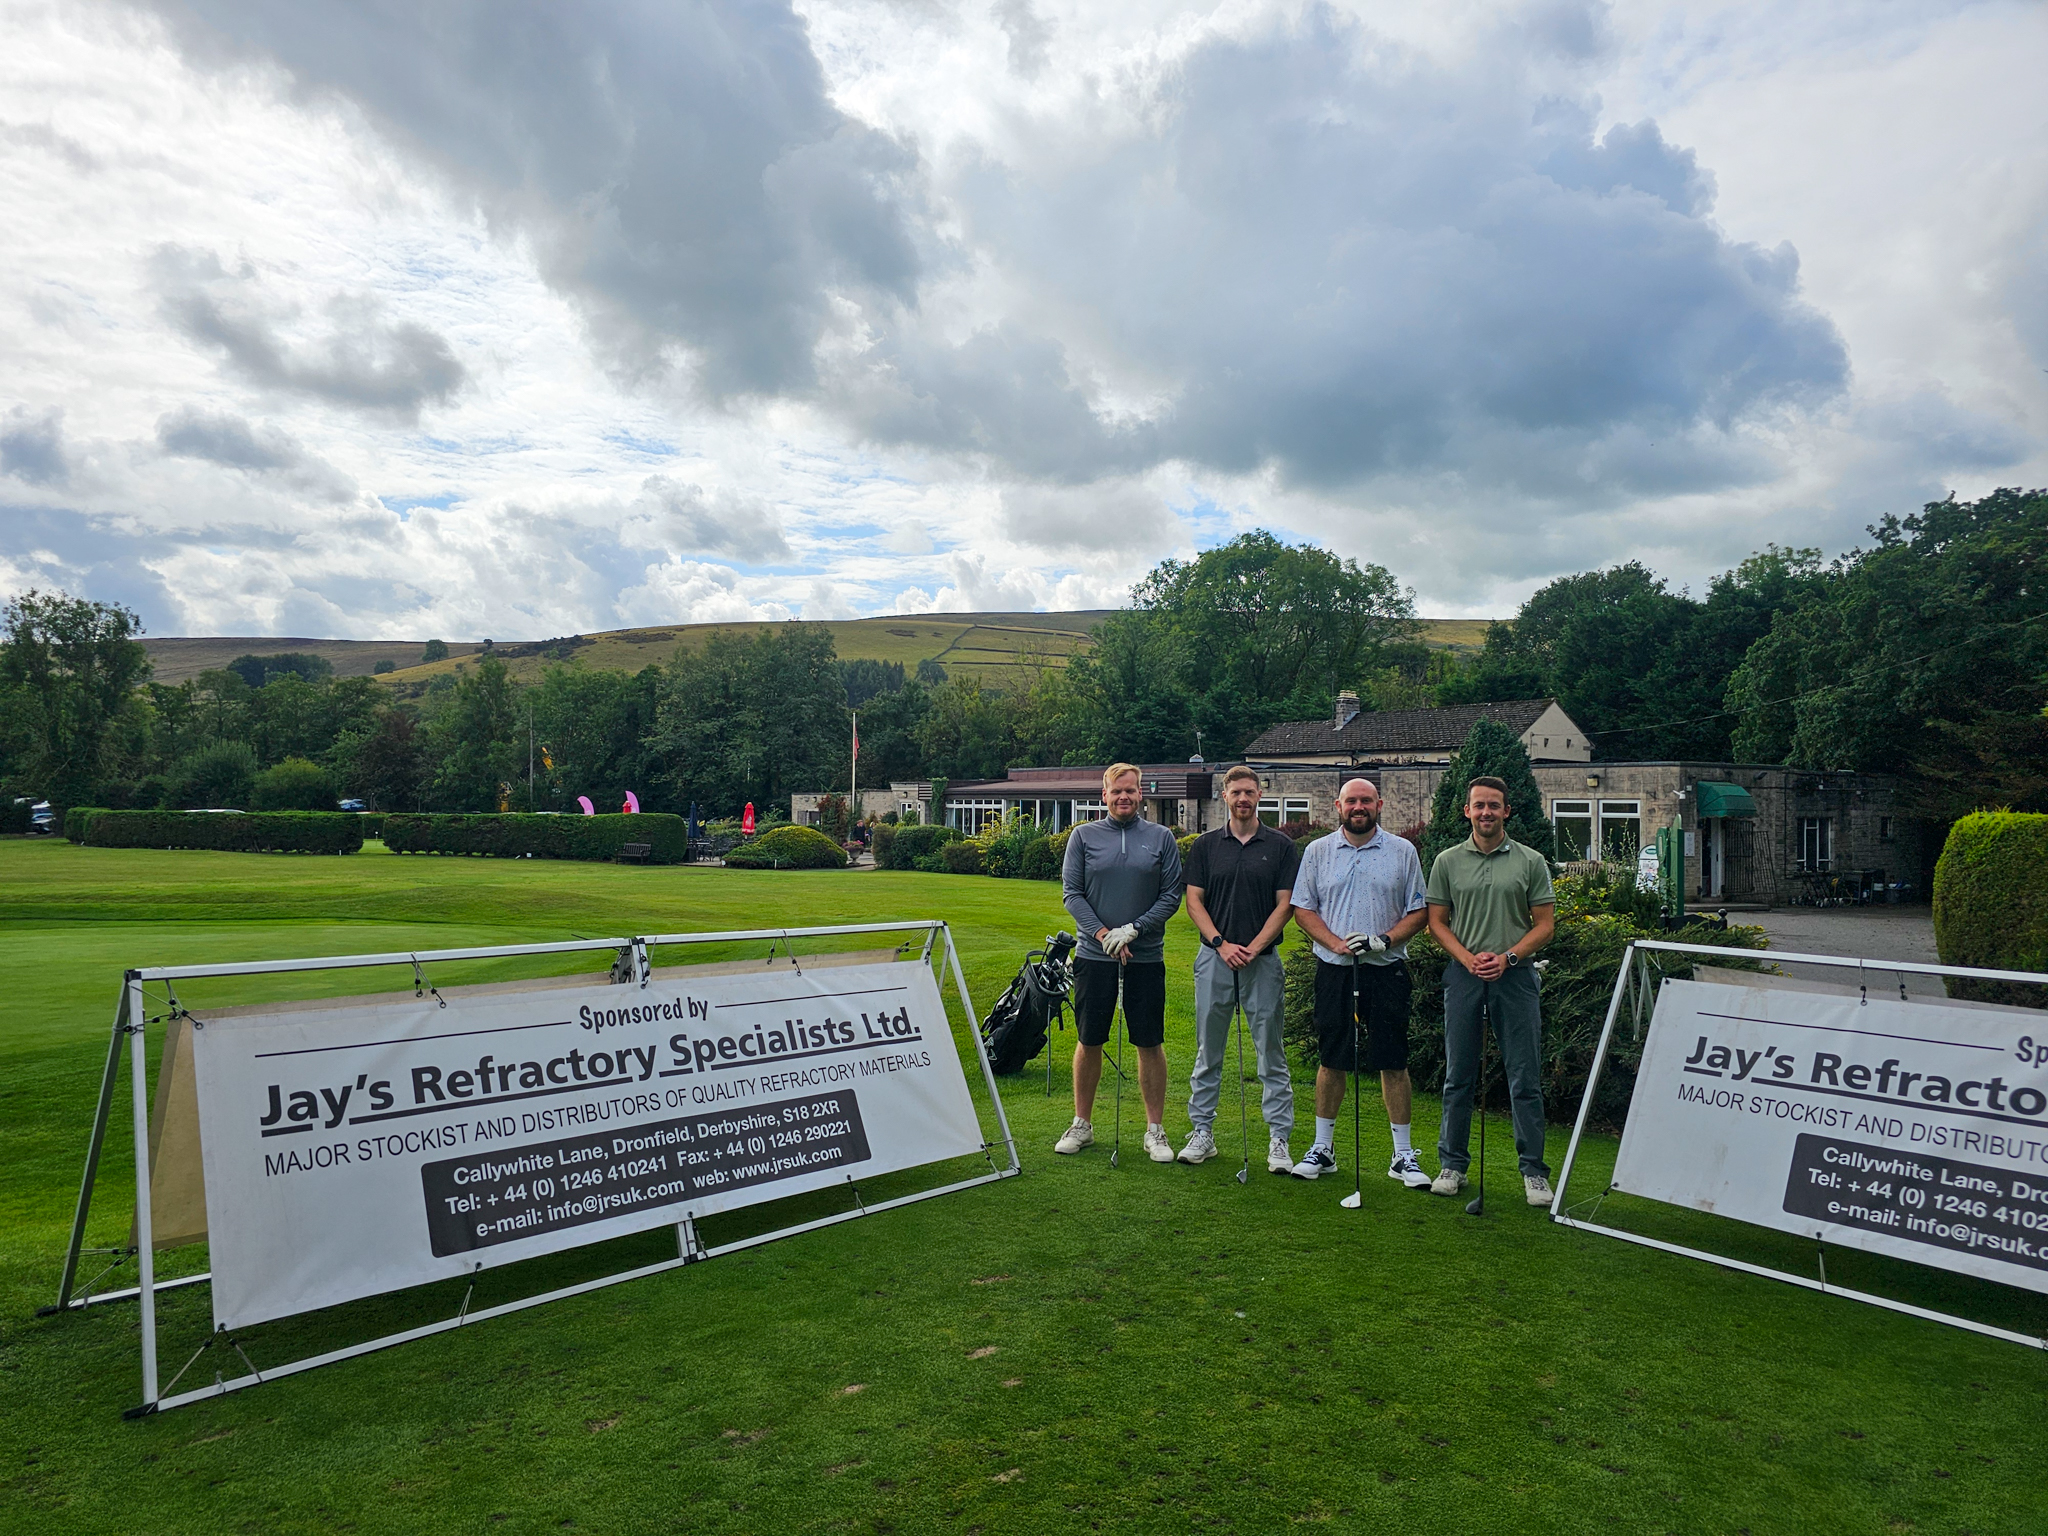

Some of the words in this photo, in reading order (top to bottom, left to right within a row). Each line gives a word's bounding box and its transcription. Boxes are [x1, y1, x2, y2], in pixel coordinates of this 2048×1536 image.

[579, 997, 683, 1034] Sponsored
[688, 997, 708, 1020] by
[411, 1045, 656, 1104] Refractory
[669, 1017, 855, 1072] Specialists
[861, 1007, 921, 1039] Ltd.
[265, 1143, 351, 1177] MAJOR
[358, 1124, 468, 1161] STOCKIST
[474, 1116, 516, 1142] AND
[522, 1093, 661, 1133] DISTRIBUTORS
[666, 1088, 687, 1107] OF
[692, 1078, 756, 1105] QUALITY
[761, 1064, 856, 1094] REFRACTORY
[860, 1051, 931, 1077] MATERIALS
[453, 1155, 553, 1185] Callywhite
[558, 1145, 609, 1166] Lane,
[612, 1127, 695, 1155] Dronfield,
[697, 1113, 781, 1142] Derbyshire,
[783, 1107, 809, 1123] S18
[813, 1100, 840, 1118] 2XR
[1678, 1084, 1744, 1111] MAJOR
[1750, 1096, 1853, 1129] STOCKIST
[1855, 1114, 1902, 1138] AND
[445, 1194, 481, 1215] Tel:
[486, 1194, 499, 1207] +
[504, 1185, 527, 1203] 44
[532, 1178, 555, 1201] (0)
[560, 1169, 603, 1191] 1246
[608, 1156, 667, 1181] 410241
[677, 1149, 710, 1169] Fax:
[713, 1148, 723, 1160] +
[726, 1141, 744, 1157] 44
[748, 1136, 765, 1156] (0)
[769, 1129, 802, 1149] 1246
[805, 1120, 851, 1142] 290221
[476, 1209, 543, 1237] e-mail:
[547, 1179, 684, 1222] info@jrsuk.com
[693, 1169, 729, 1189] web:
[732, 1146, 842, 1180] www.jrsuk.com
[1808, 1168, 1840, 1189] Tel:
[1848, 1181, 1860, 1191] +
[1866, 1181, 1892, 1198] 44
[1899, 1187, 1925, 1209] (0)
[1933, 1194, 1986, 1218] 1246
[1823, 1147, 1933, 1181] Callywhite
[1940, 1169, 2003, 1197] Lane,
[1827, 1201, 1900, 1227] e-mail:
